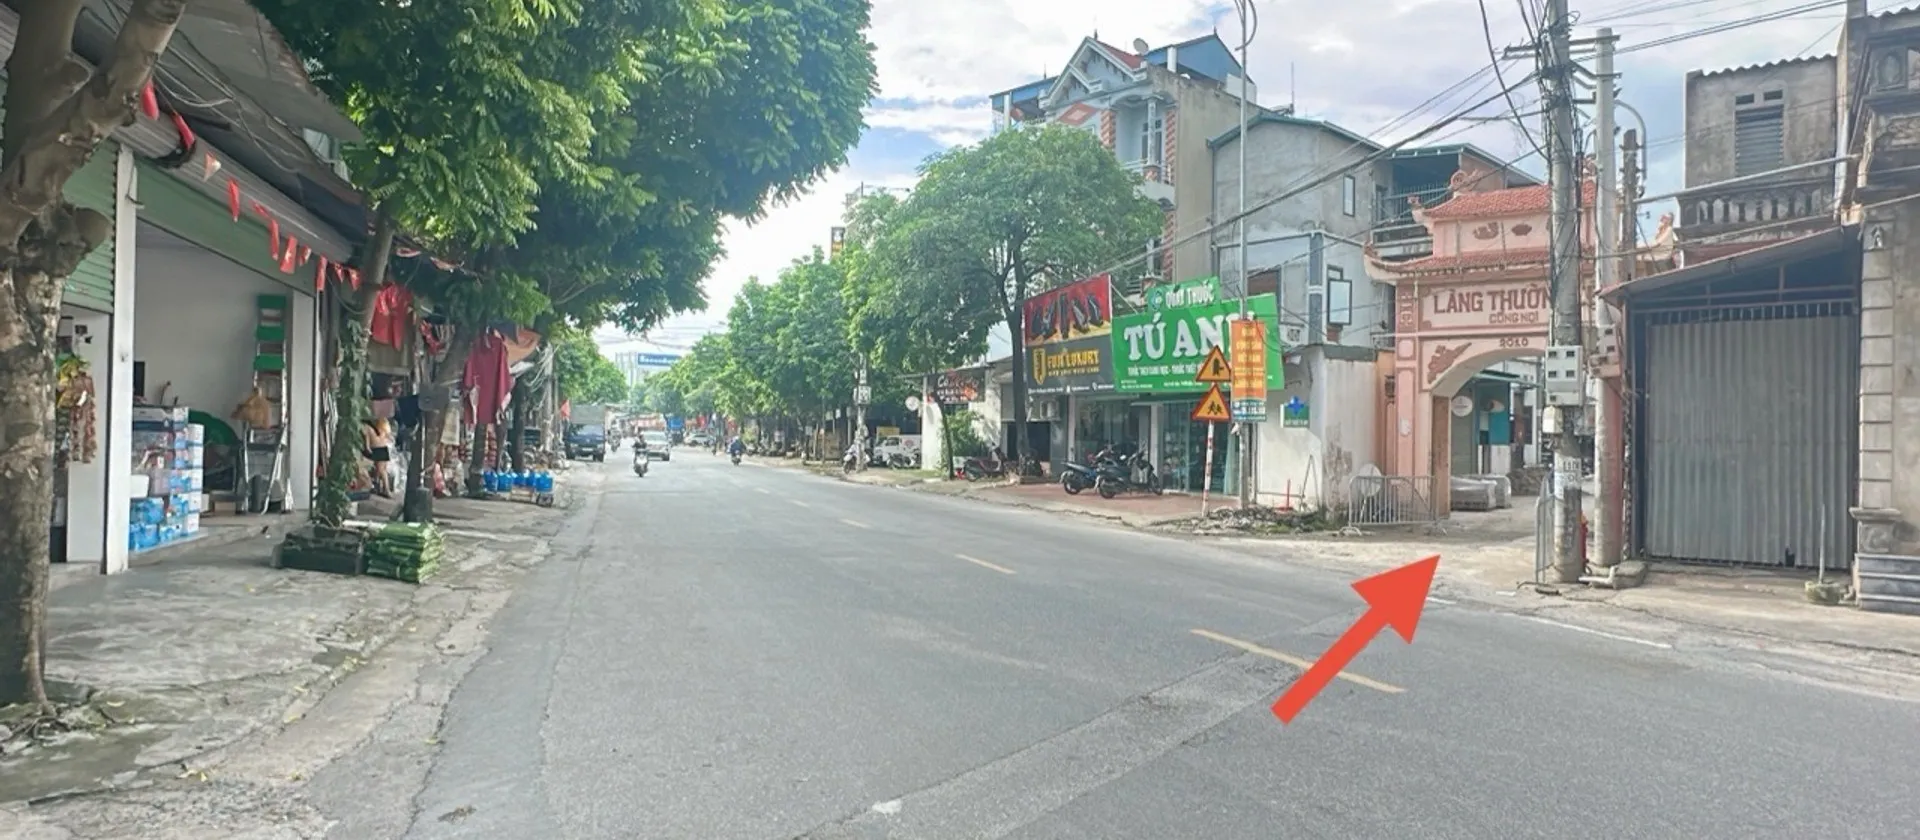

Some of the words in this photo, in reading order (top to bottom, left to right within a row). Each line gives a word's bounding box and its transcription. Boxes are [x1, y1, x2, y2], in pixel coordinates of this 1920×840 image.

[1433, 288, 1484, 314] LÀNG
[1123, 311, 1166, 361] TÚ
[1499, 337, 1529, 348] 2010
